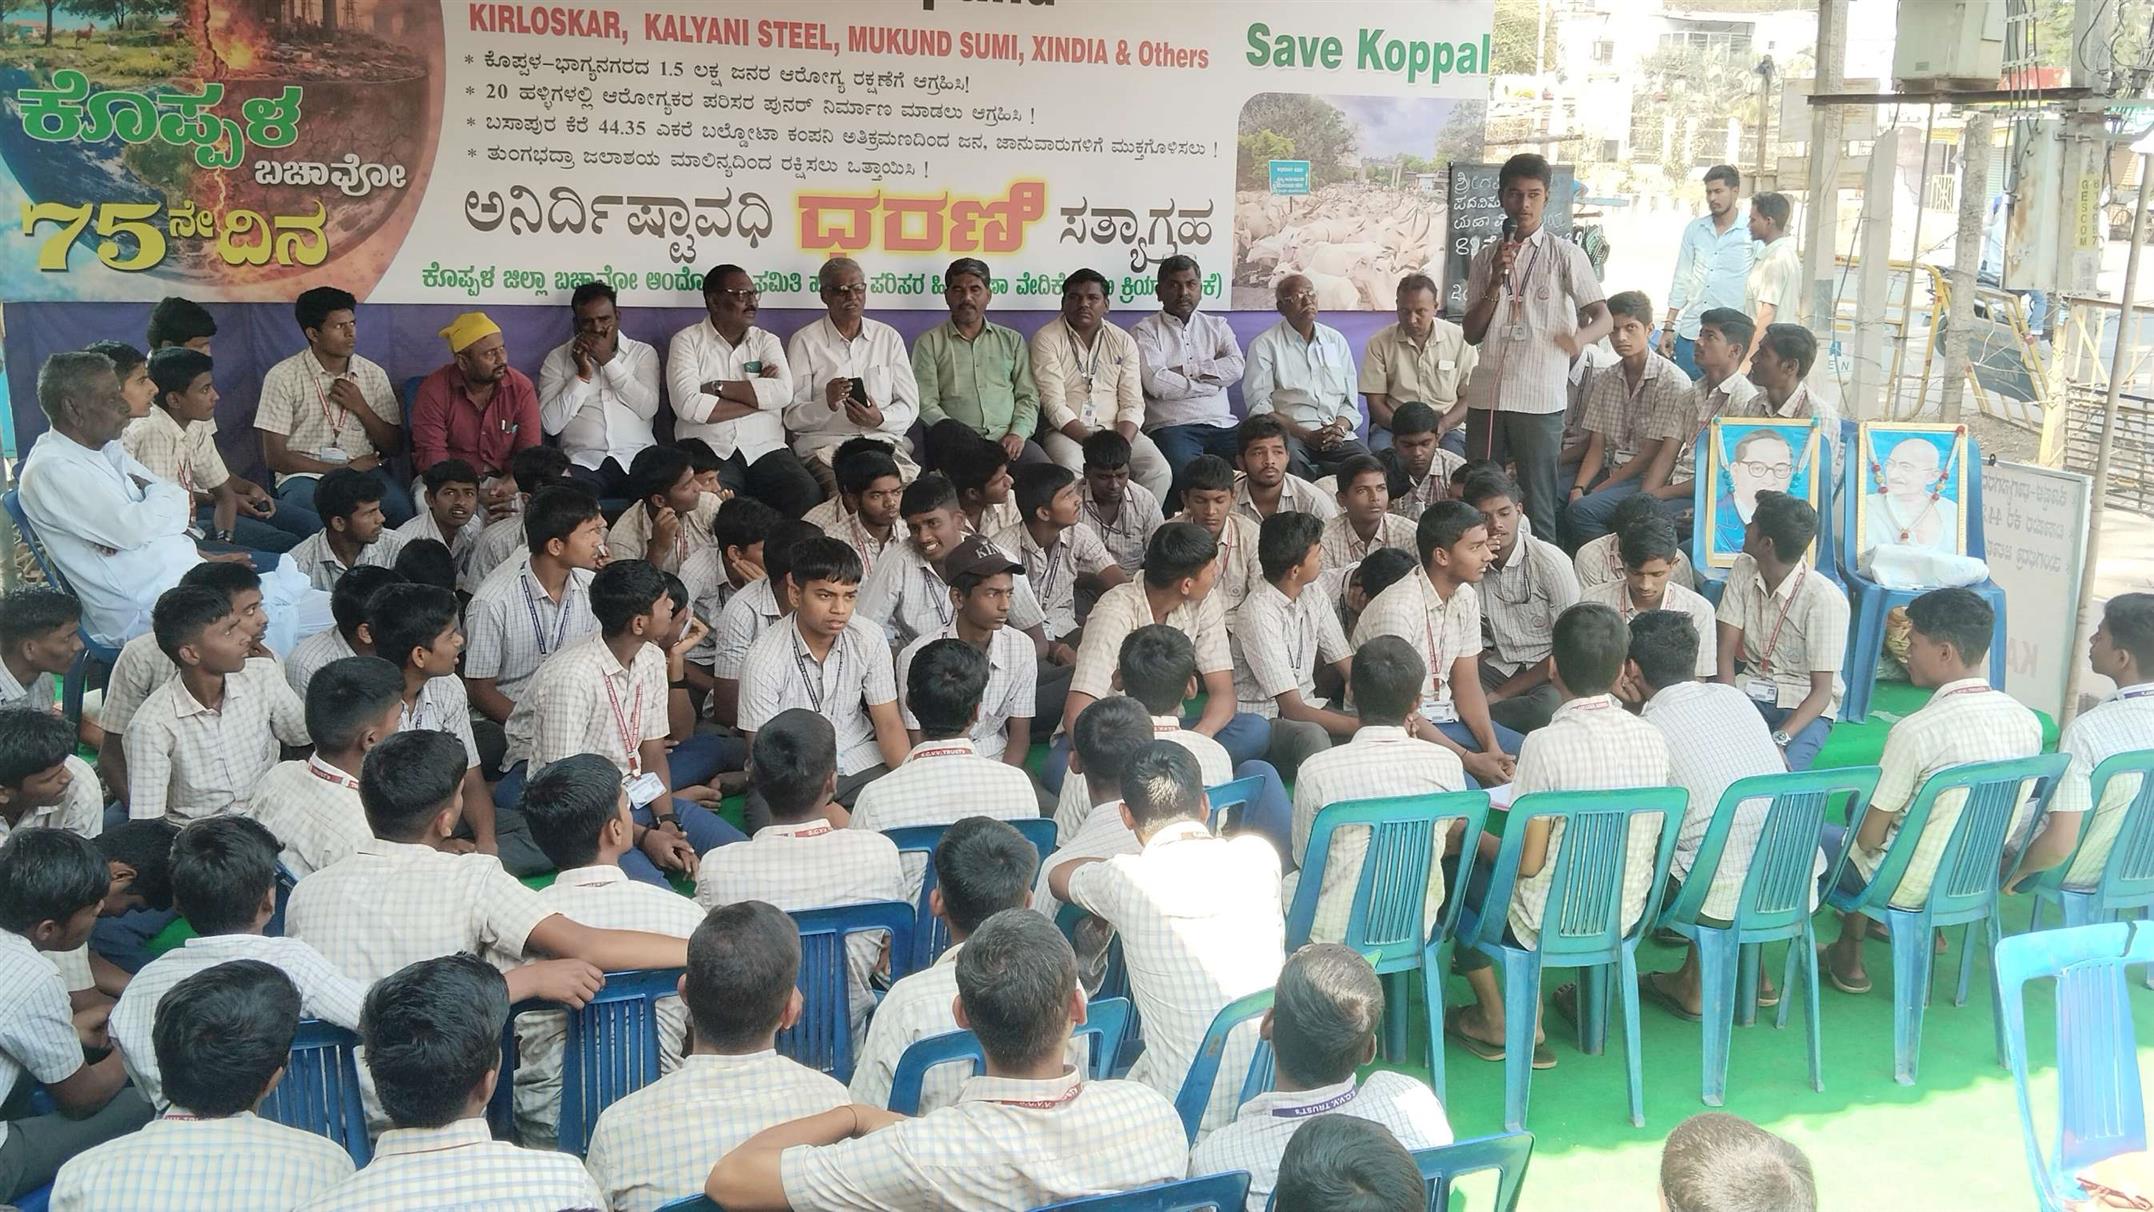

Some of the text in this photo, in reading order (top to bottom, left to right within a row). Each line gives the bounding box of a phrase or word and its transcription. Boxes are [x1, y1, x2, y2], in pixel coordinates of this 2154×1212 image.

[469, 3, 1209, 69] KIRLOSKAR, KALYANI STEEL, MUKUND SUMI, XINDIA & Others
[1246, 23, 1491, 84] Save Koppal
[659, 61, 684, 78] 1.5
[694, 64, 722, 87] ಲಕ್ಷ
[730, 65, 771, 83] ಜನರ
[779, 65, 846, 94] ಆರೋಗ್ಯ
[853, 70, 905, 95] ರಕ್ಷಣೆಗೆ
[18, 68, 304, 169] ಕೊಪ್ಪಳ
[486, 84, 508, 100] 20
[519, 84, 594, 110] ಹಳ್ಳಿಗಳಲ್ಲಿ
[602, 87, 694, 115] ಆರೋಗ್ಯಕರ
[703, 93, 754, 111] ಪರಿಸರ
[764, 96, 813, 116] ಪುನರ್
[823, 98, 893, 118] ನಿರ್ಮಾಣ
[901, 102, 963, 120] ಮಾಡಲು
[485, 114, 557, 136] ಬಸಾಪುರ
[565, 114, 589, 134] ಕೆರೆ
[598, 120, 647, 136] 44.35
[656, 120, 694, 139] ಎಕರೆ
[702, 121, 779, 147] ಬಲ್ಡೋಟಾ
[787, 127, 834, 144] ಕಂಪನಿ
[842, 129, 950, 151] ಅತಿಕ್ರಮಣದಿಂದ
[996, 134, 1103, 154] ಜಾನುವಾರುಗಳಿಗೆ
[254, 152, 407, 196] ಬಚಾವೋ
[487, 145, 576, 170] ತುಂಗಭದ್ರಾ
[583, 147, 661, 167] ಜಲಾಶಯ
[671, 151, 773, 177] ಮಾಲಿನ್ಯದಿಂದ
[780, 155, 839, 179] ರಕ್ಷಿಸಲು
[847, 158, 916, 181] ಒತ್ತಾಯಿಸಿ
[216, 199, 330, 268] ದಿನ
[464, 181, 1214, 274] ಅನಿರ್ದಿಷ್ಟಾವಧಿ ಧರಣಿ ಸತ್ಯಾಗ್ರಹ
[422, 260, 496, 297] ಕೊಪ್ಪಳ
[502, 268, 549, 297] ಜಿಲ್ಲಾ
[870, 272, 926, 296] ಪರಿಸರ
